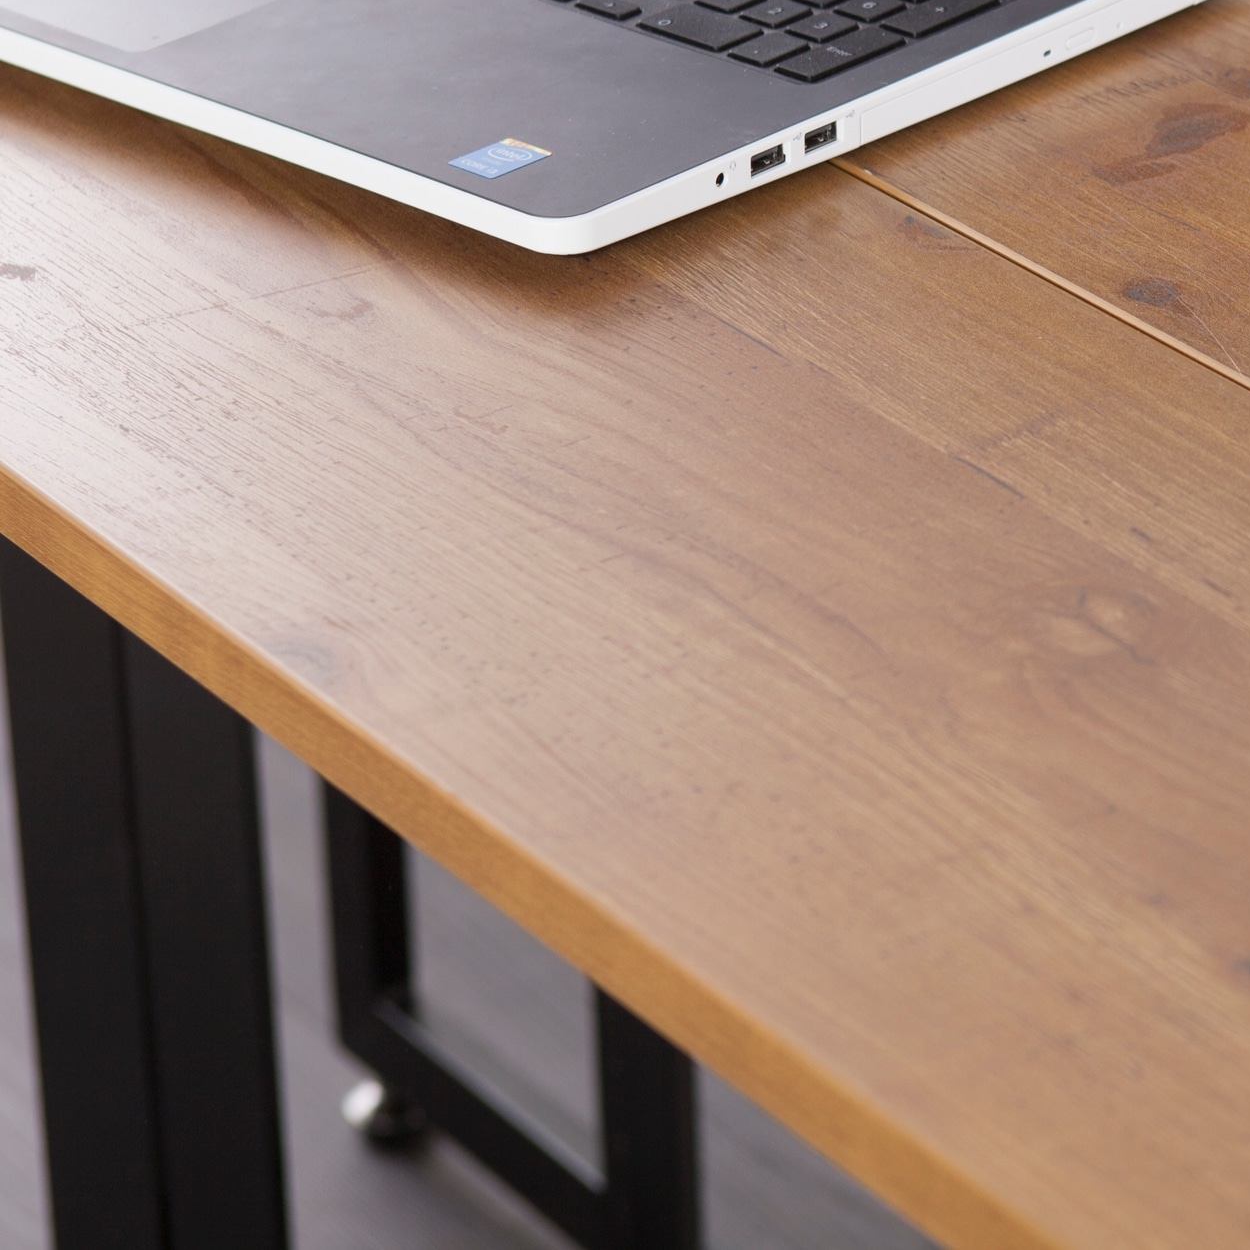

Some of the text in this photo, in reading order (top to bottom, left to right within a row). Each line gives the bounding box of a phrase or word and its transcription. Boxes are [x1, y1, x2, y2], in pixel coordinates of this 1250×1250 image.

[826, 45, 854, 58] Enter
[495, 147, 527, 161] intel
[460, 158, 488, 171] CORE
